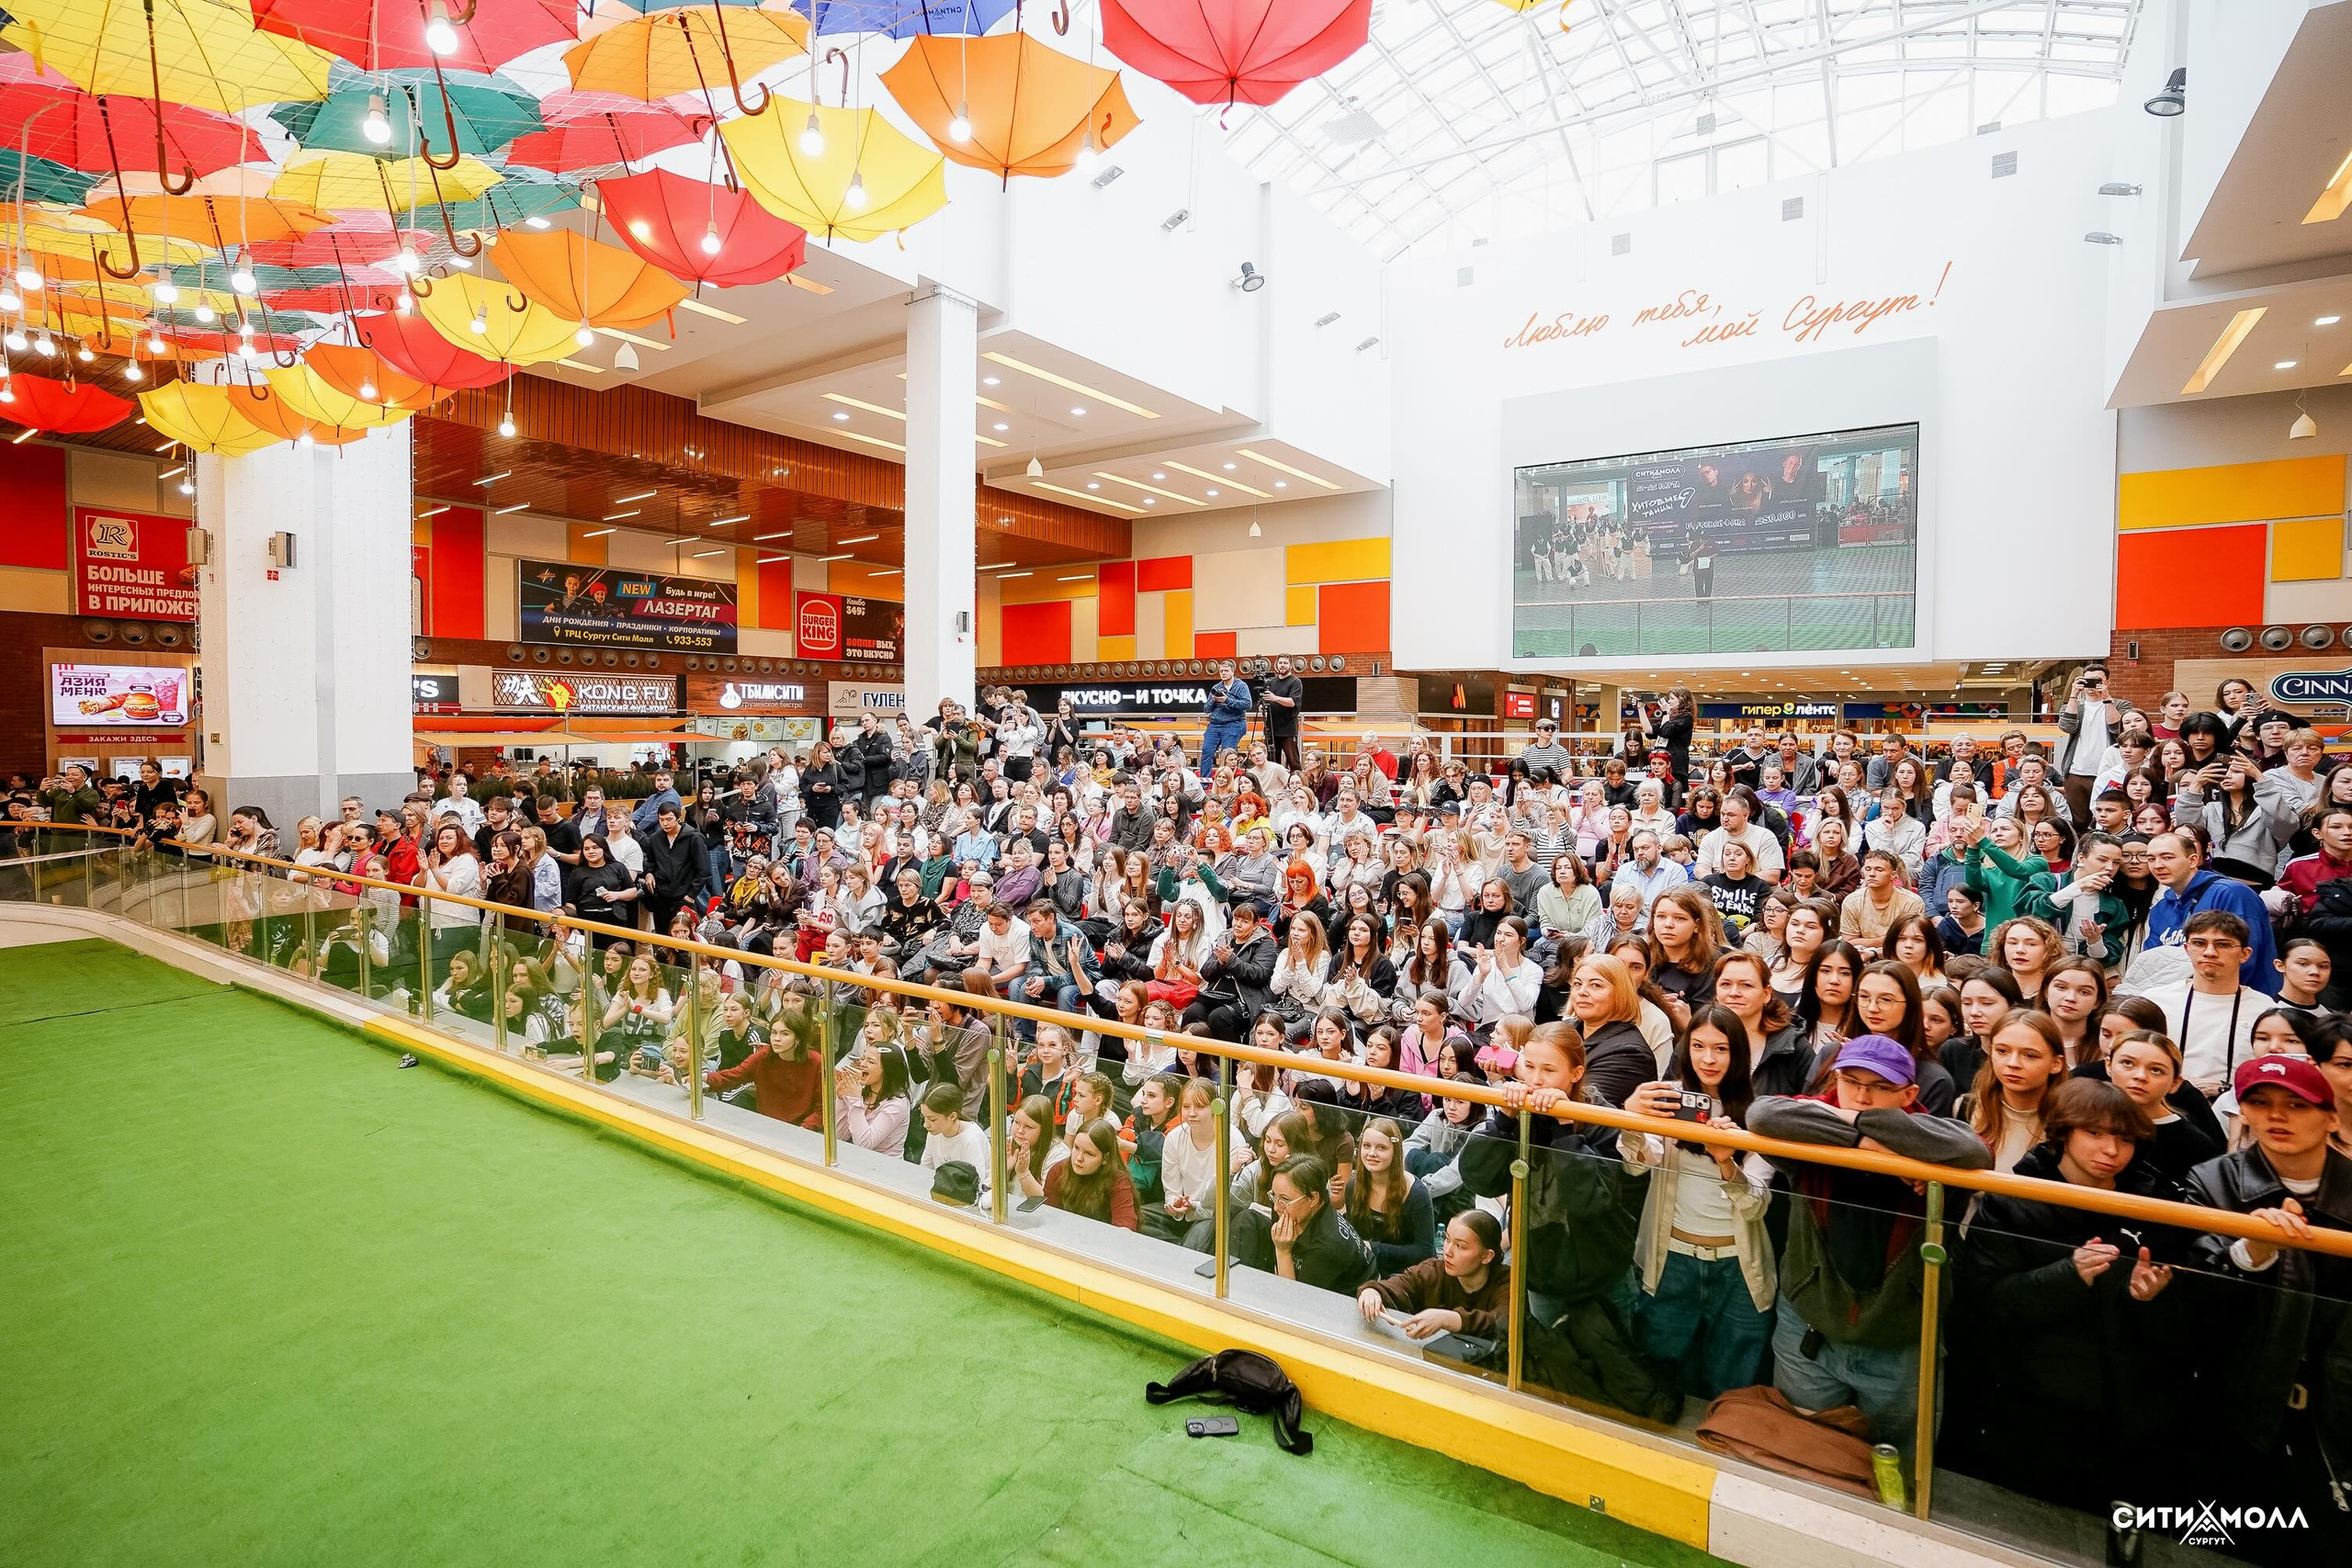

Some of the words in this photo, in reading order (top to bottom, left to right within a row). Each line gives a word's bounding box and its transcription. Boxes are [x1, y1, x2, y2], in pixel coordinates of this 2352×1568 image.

[89, 549, 137, 559] ROSTIC'S
[87, 565, 165, 585] БОЛЬШЕ
[87, 583, 154, 596] ИНТЕРЕСНЫХ
[622, 583, 651, 595] NEW
[665, 586, 685, 597] Будь
[88, 595, 101, 610] В
[643, 600, 719, 619] ЛАЗЕРТАГ
[542, 615, 561, 624] ДНИ
[563, 617, 609, 627] РОЖДЕНИЯ
[616, 622, 662, 631] ПРАЗДНИКИ
[669, 626, 721, 636] КОРПОРАТИВЫ
[802, 615, 834, 626] BURGER
[564, 629, 582, 639] ТРЦ
[583, 631, 611, 642] Сургут
[612, 634, 631, 642] Сити
[632, 635, 653, 643] Молл
[673, 635, 712, 647] 933-553
[802, 624, 835, 640] KING
[846, 649, 863, 658] ЭТО
[863, 650, 894, 660] ВКУСНО
[60, 677, 106, 687] АЗИЯ
[2282, 678, 2352, 696] CINN
[60, 686, 107, 697] МЕНЮ
[578, 683, 638, 701] KONG
[643, 685, 669, 701] FU
[740, 683, 804, 701] ТБИЛИСИТИ
[1151, 688, 1207, 705] ТОЧКА
[780, 701, 803, 709] бистро
[1742, 705, 1782, 716] гипер
[1712, 886, 1758, 905] SMILE
